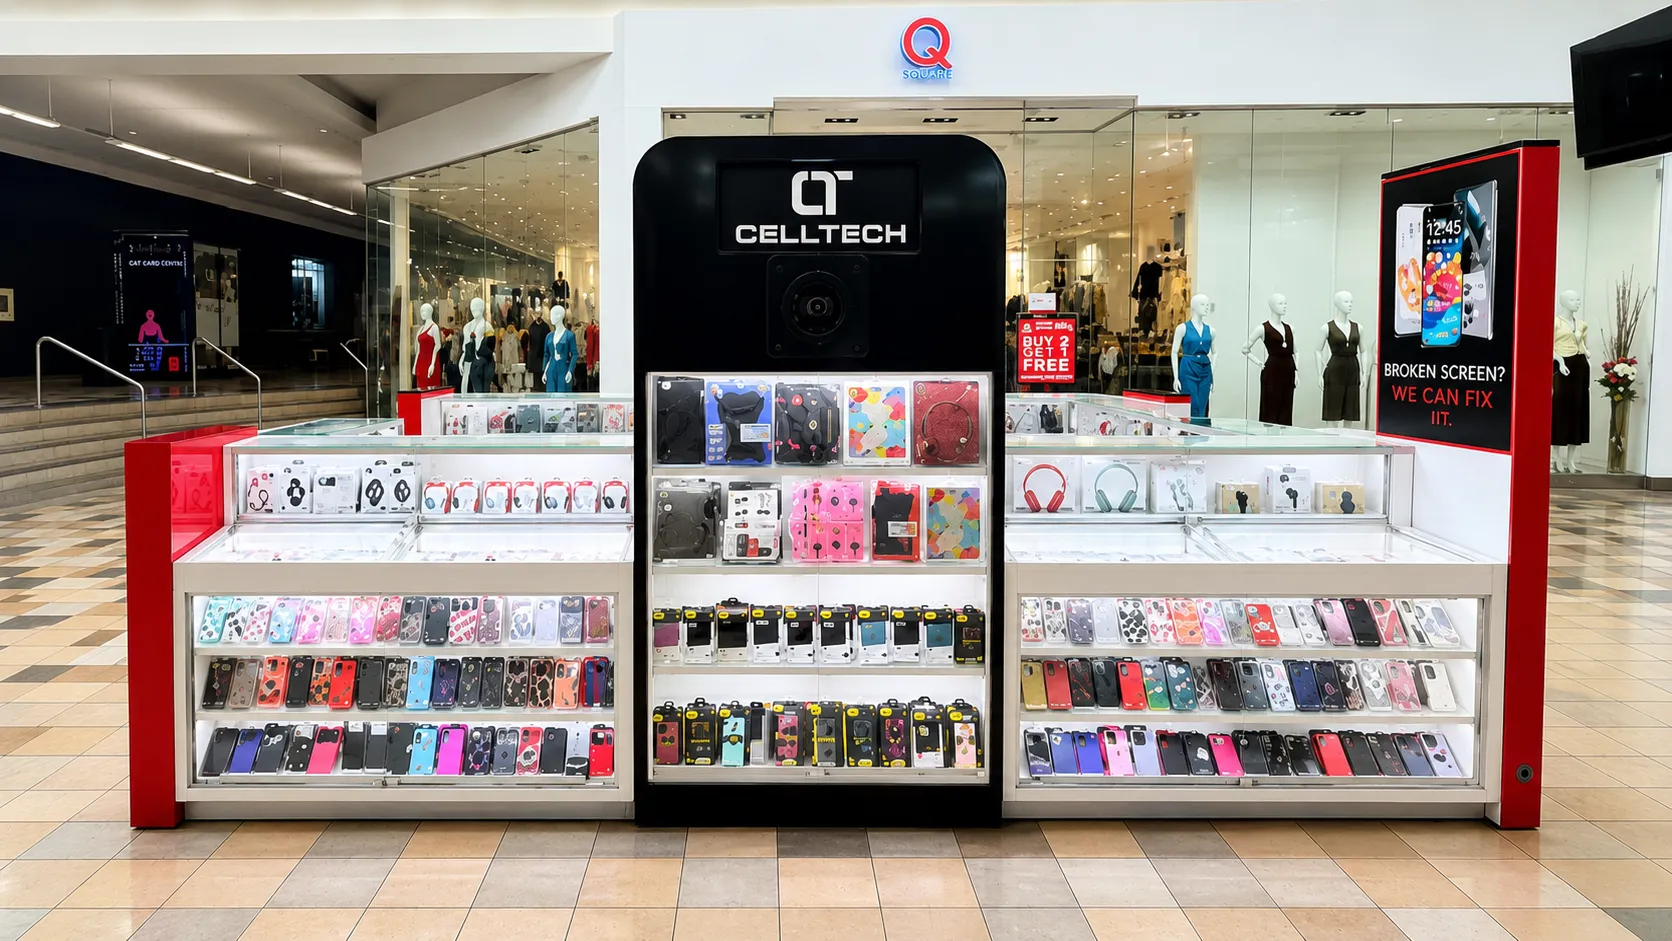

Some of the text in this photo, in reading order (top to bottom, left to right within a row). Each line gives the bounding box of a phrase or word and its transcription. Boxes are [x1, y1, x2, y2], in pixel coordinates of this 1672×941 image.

[900, 16, 953, 69] Q
[902, 69, 953, 80] SQUARE
[735, 224, 907, 244] CELLTECH
[1023, 336, 1070, 347] BUY 2
[1023, 347, 1067, 357] GET 1
[1023, 358, 1069, 371] FREE
[1384, 362, 1506, 382] BROKEN SCREEN?
[1391, 384, 1493, 409] WE CAN FIX
